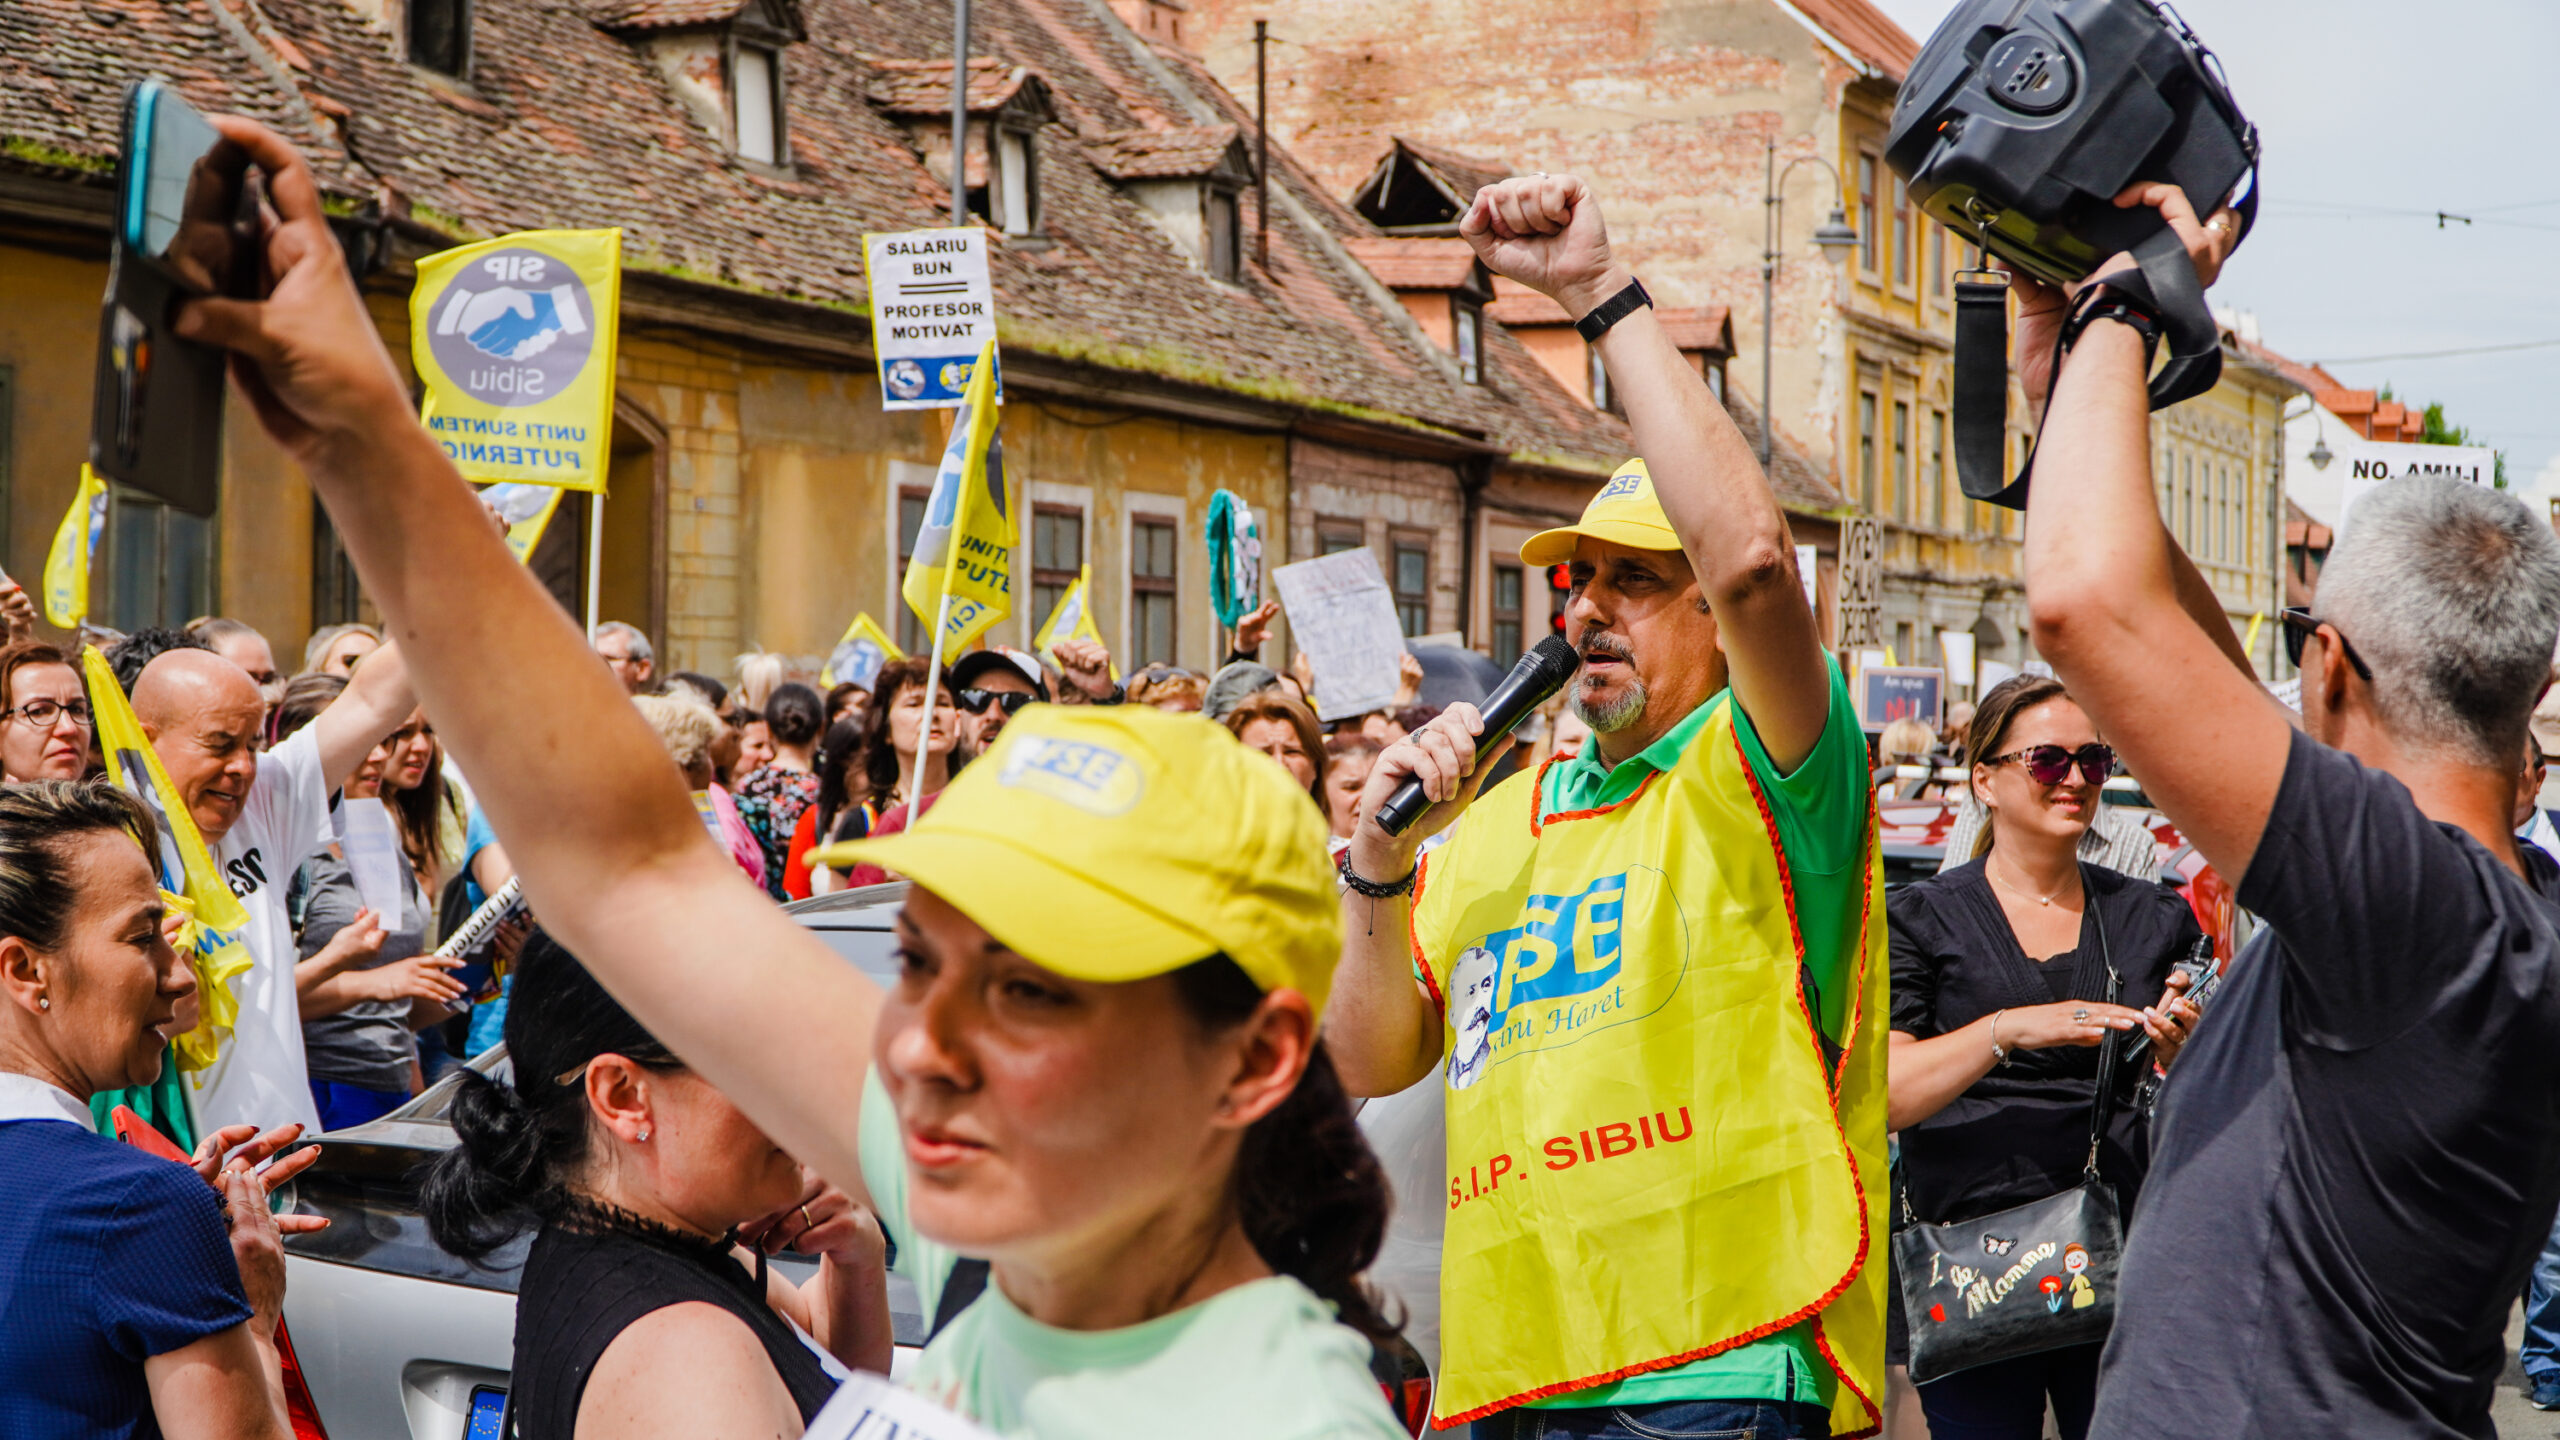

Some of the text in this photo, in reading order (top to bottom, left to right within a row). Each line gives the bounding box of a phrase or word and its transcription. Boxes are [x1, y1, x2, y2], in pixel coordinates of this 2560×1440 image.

[886, 239, 968, 256] SALARIU
[913, 261, 953, 276] BUN
[884, 302, 984, 319] PROFESOR
[891, 323, 975, 340] MOTIVAT
[2352, 459, 2396, 480] NO.
[1036, 742, 1116, 787] FSE
[1546, 985, 1626, 1035] Haret
[1543, 1106, 1694, 1172] SIBIU
